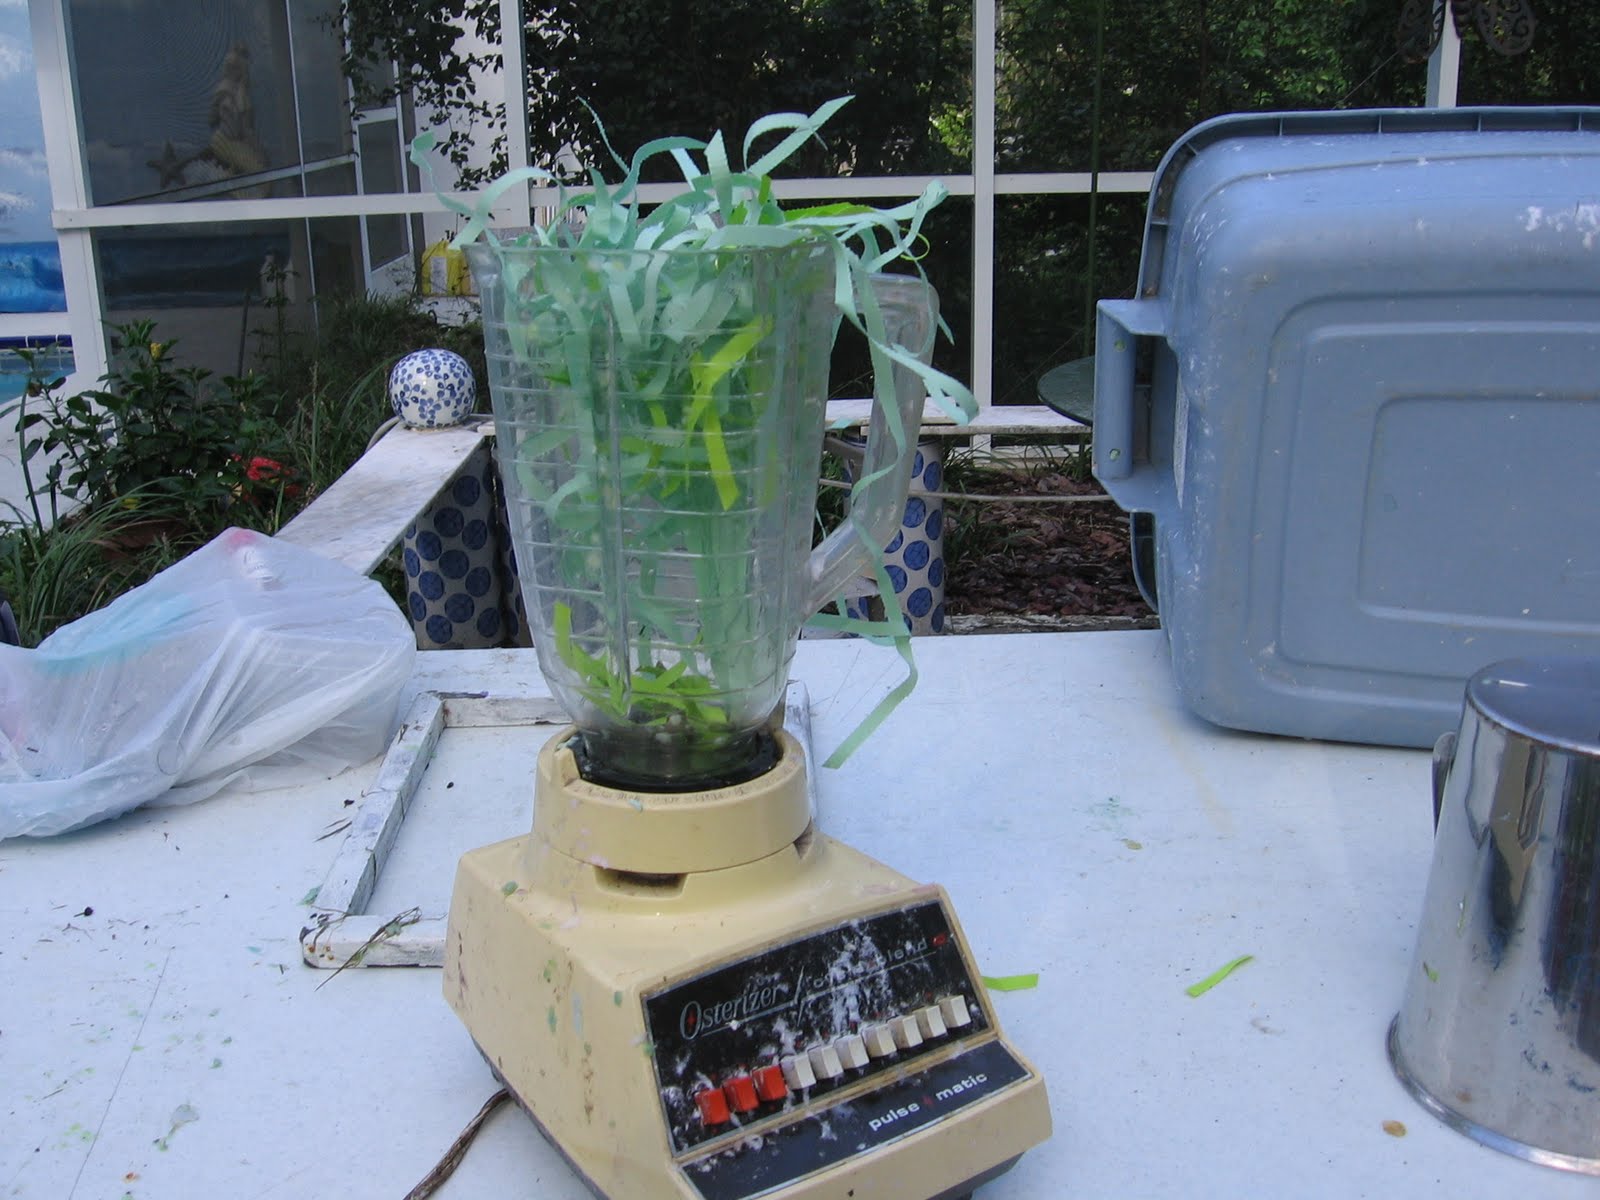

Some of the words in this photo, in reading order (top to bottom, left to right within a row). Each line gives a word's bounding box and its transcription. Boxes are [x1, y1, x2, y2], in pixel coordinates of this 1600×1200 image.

[680, 983, 780, 1040] Osterizer
[868, 1101, 921, 1132] pulse
[935, 1072, 988, 1101] matic
